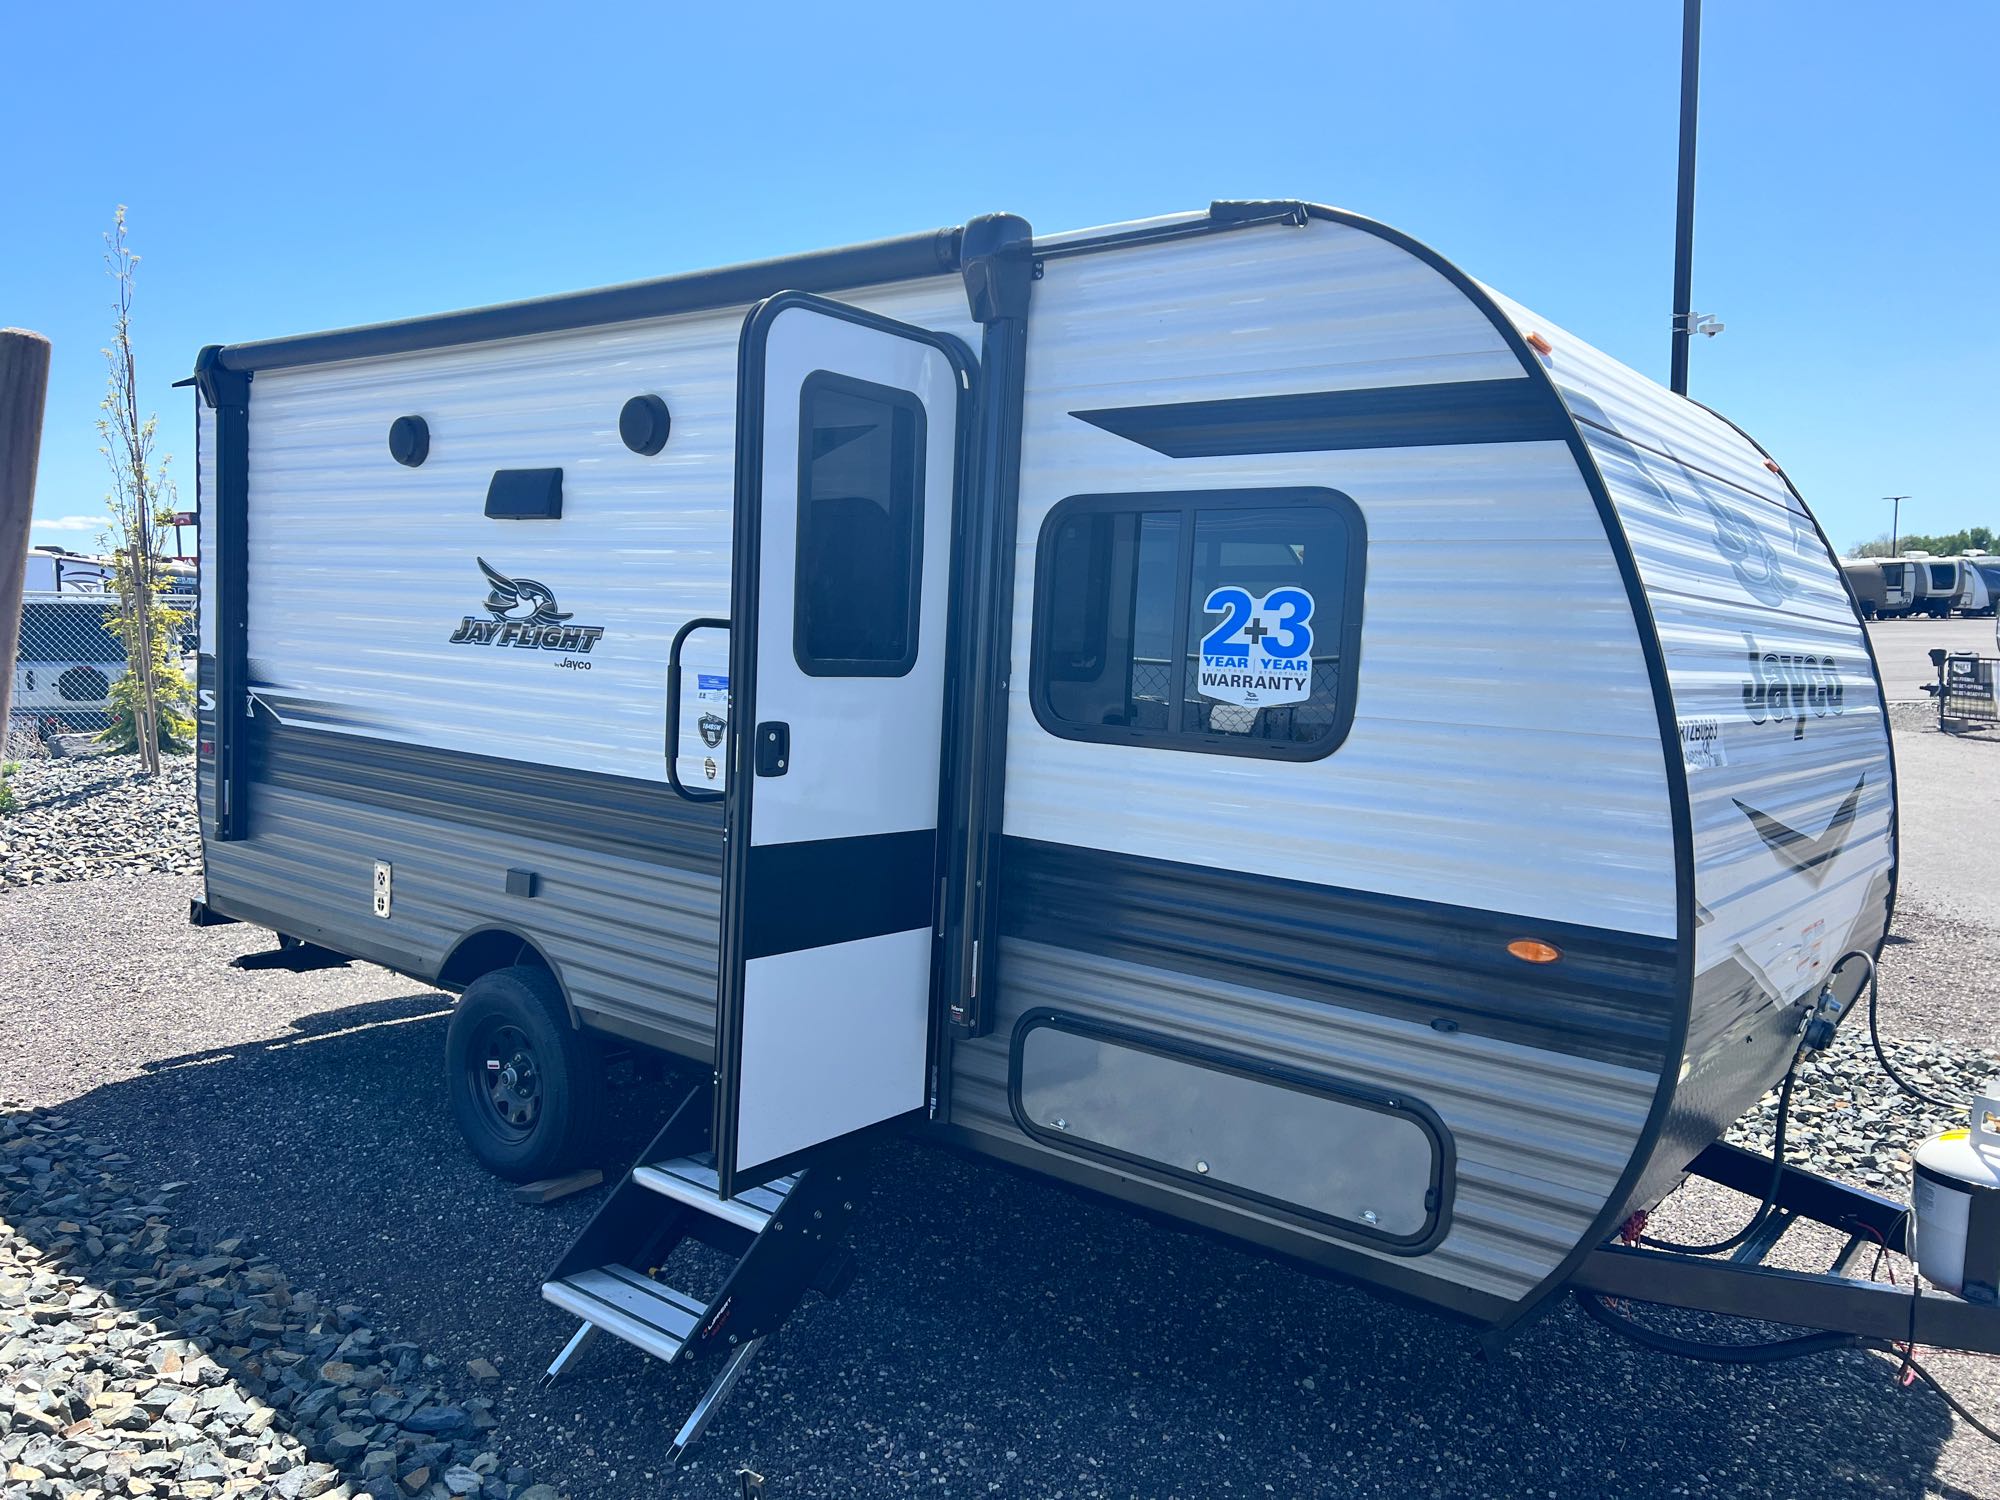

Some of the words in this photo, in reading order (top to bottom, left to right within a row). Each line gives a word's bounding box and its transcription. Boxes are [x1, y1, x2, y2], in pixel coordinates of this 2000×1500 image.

[449, 616, 503, 646] JAY
[497, 620, 604, 653] FLIGHT
[560, 657, 592, 671] Jayco
[1204, 656, 1249, 669] YEAR
[1260, 658, 1308, 672] YEAR
[1202, 673, 1307, 692] WARRANTY
[1741, 630, 1844, 741] Jayco
